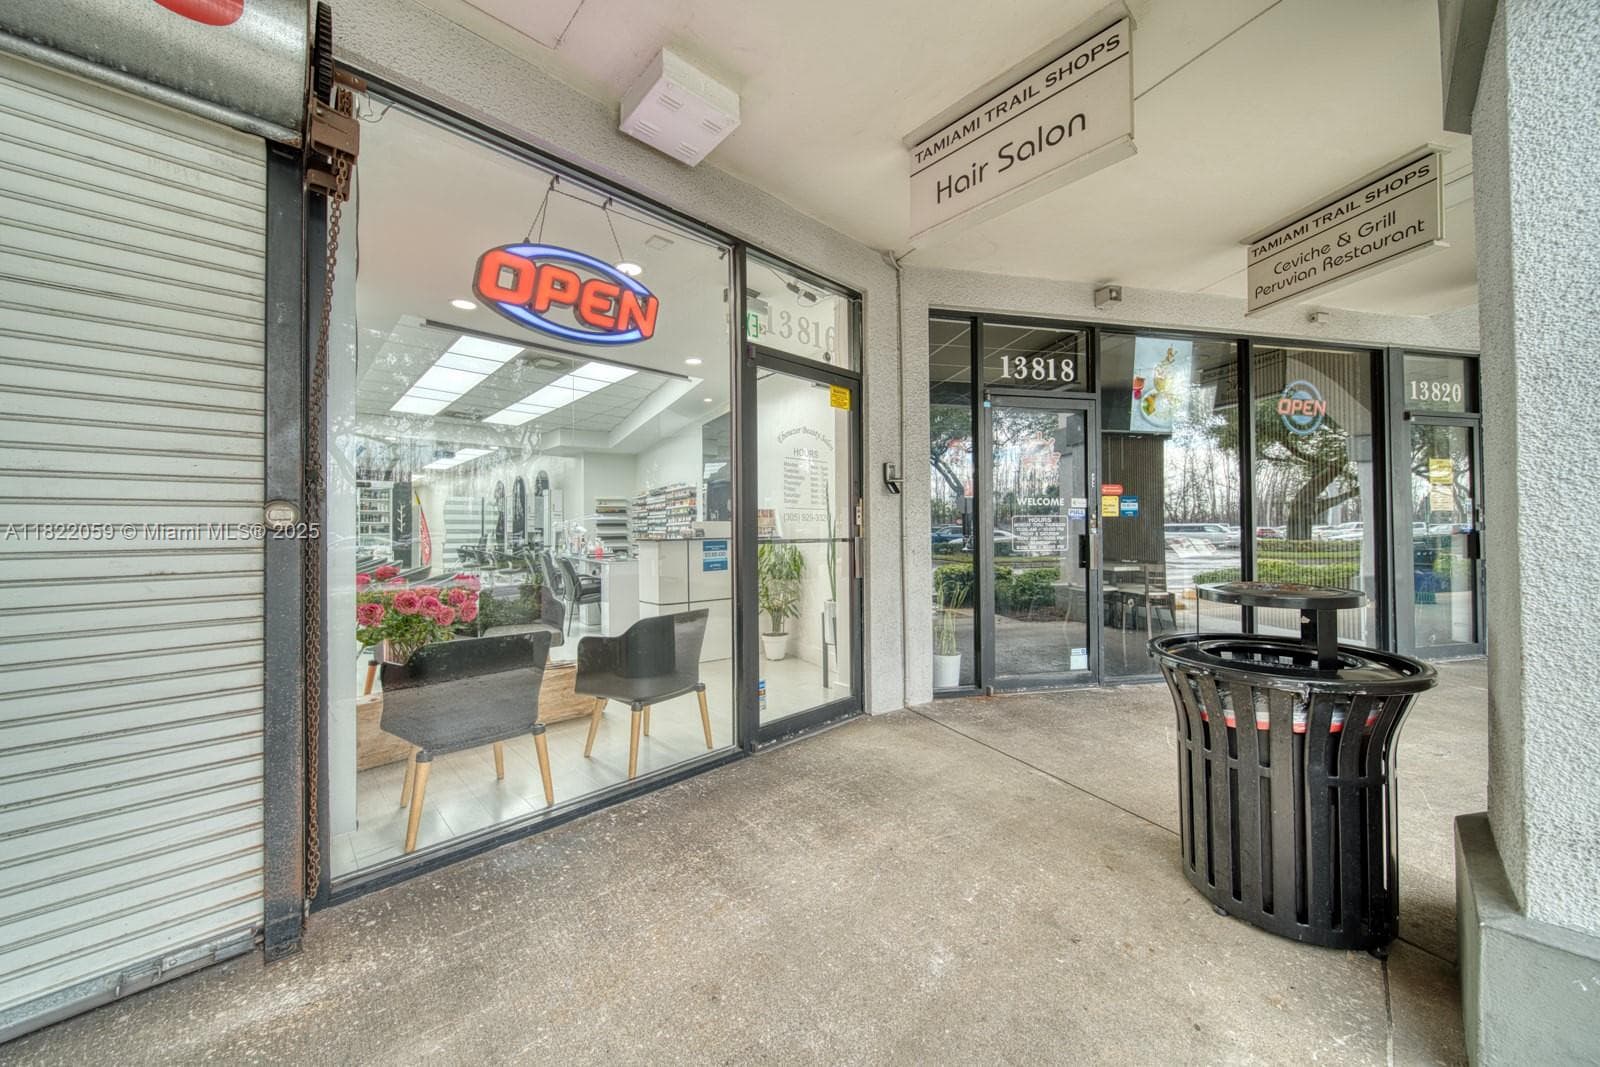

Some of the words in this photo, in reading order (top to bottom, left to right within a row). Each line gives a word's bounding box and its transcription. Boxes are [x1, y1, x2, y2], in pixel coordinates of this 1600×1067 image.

[914, 117, 980, 164] TAMIAMI
[984, 85, 1040, 123] TRAIL
[1045, 34, 1120, 88] SHOPS
[937, 162, 989, 204] Hair
[998, 112, 1086, 173] Salon
[1251, 223, 1309, 258] TAMIAMI
[1312, 200, 1361, 229] TRAIL
[1365, 164, 1430, 204] SHOPS
[1273, 244, 1331, 275] Ceviche
[1336, 232, 1351, 247] &
[1358, 210, 1396, 238] Grill
[477, 248, 660, 339] OPEN
[1255, 266, 1317, 299] Peruvian
[1322, 219, 1425, 272] Restaurant
[1000, 355, 1075, 382] 13818
[1410, 380, 1462, 402] 13820
[1277, 398, 1327, 416] OPEN
[1016, 497, 1065, 506] WELCOME
